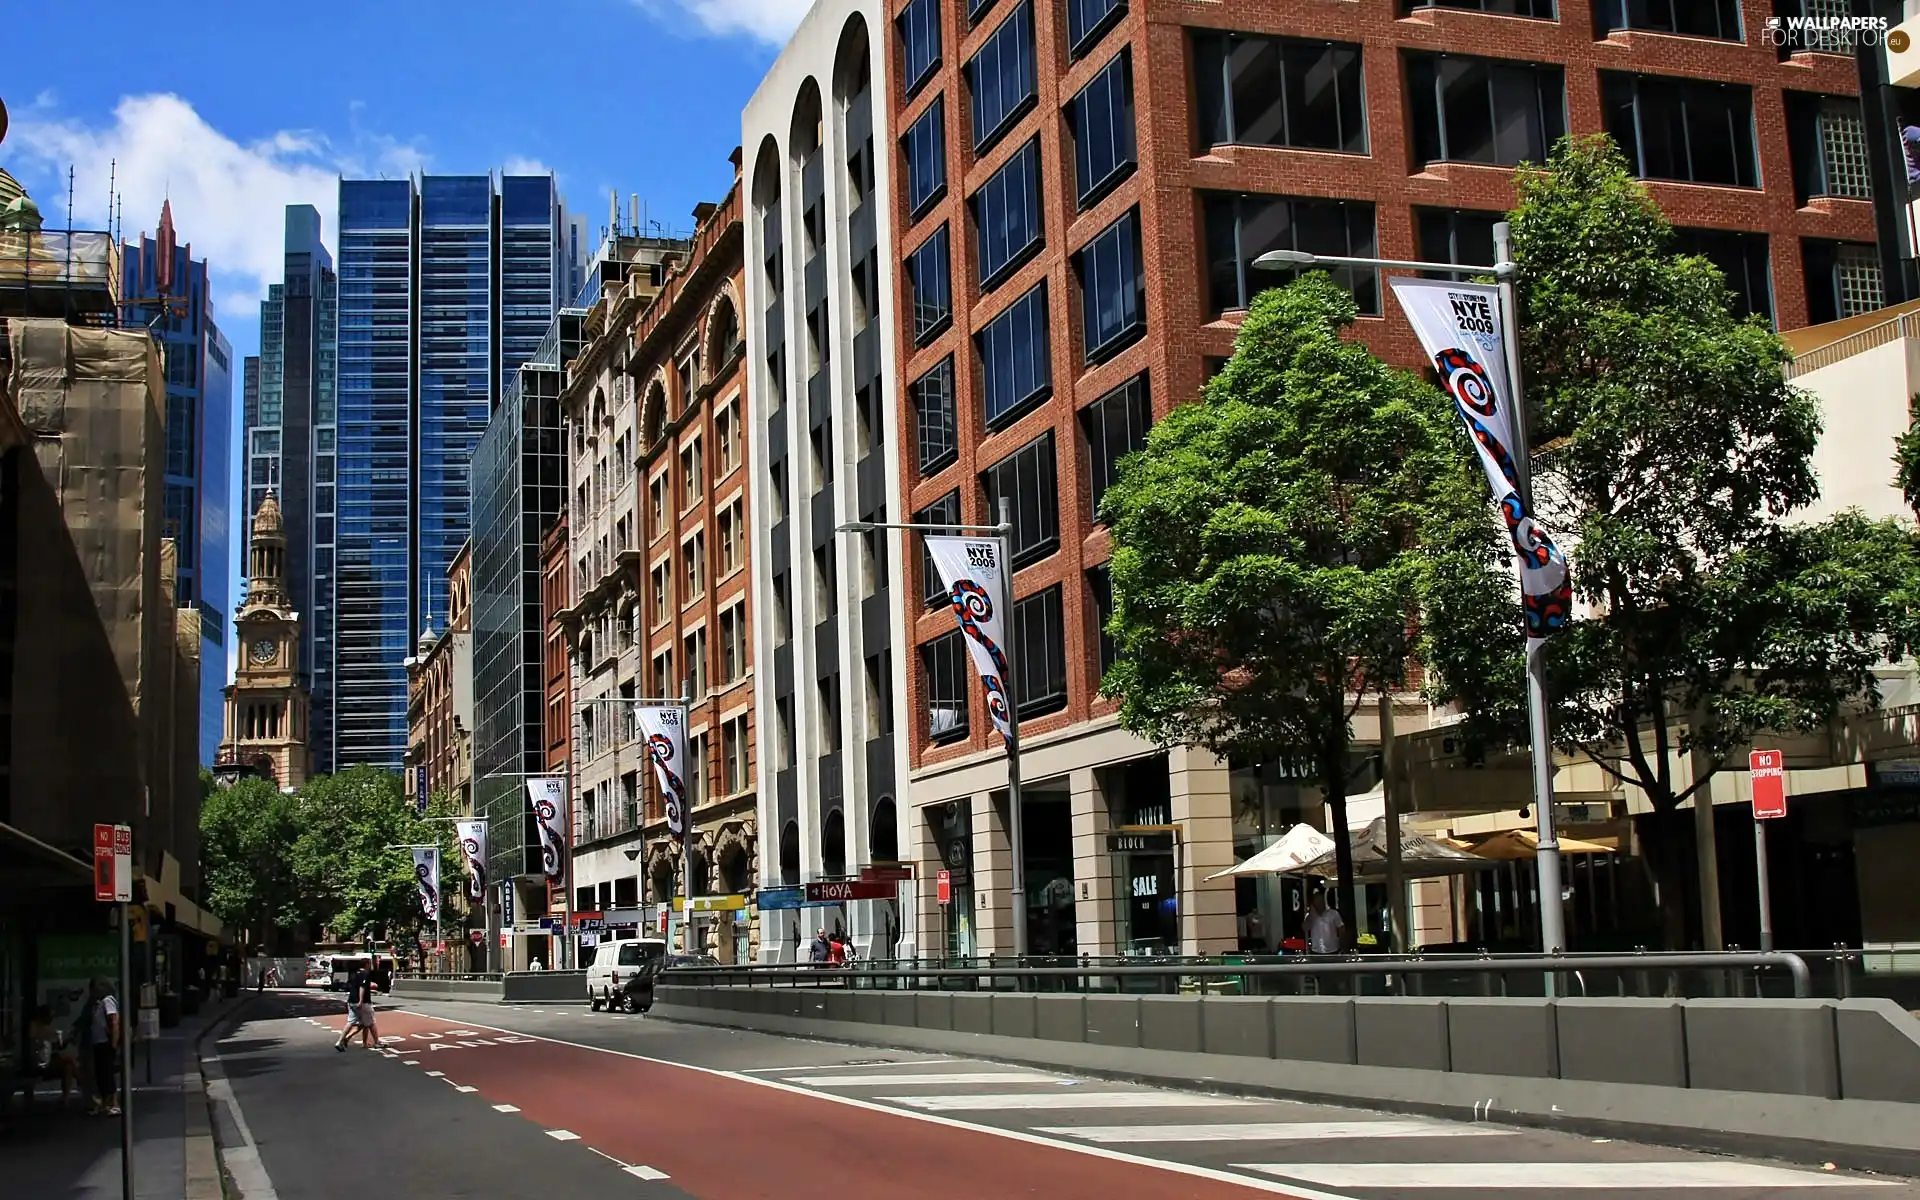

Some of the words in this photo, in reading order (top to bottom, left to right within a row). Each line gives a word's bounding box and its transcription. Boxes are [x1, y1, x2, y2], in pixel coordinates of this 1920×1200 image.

[1450, 300, 1491, 320] NYE
[1457, 316, 1494, 334] 2009
[966, 548, 994, 559] NYE
[970, 557, 996, 568] 2009
[659, 712, 678, 720] NYE
[661, 718, 679, 726] 2009
[1759, 755, 1772, 766] NO
[1752, 767, 1782, 778] STOPPING
[100, 831, 109, 841] NO
[116, 831, 130, 842] BUS
[1117, 838, 1145, 849] BLOCH
[821, 883, 853, 899] HOYA
[1133, 875, 1158, 897] SALE
[378, 1029, 479, 1044] BUS
[384, 1036, 537, 1055] LANE
